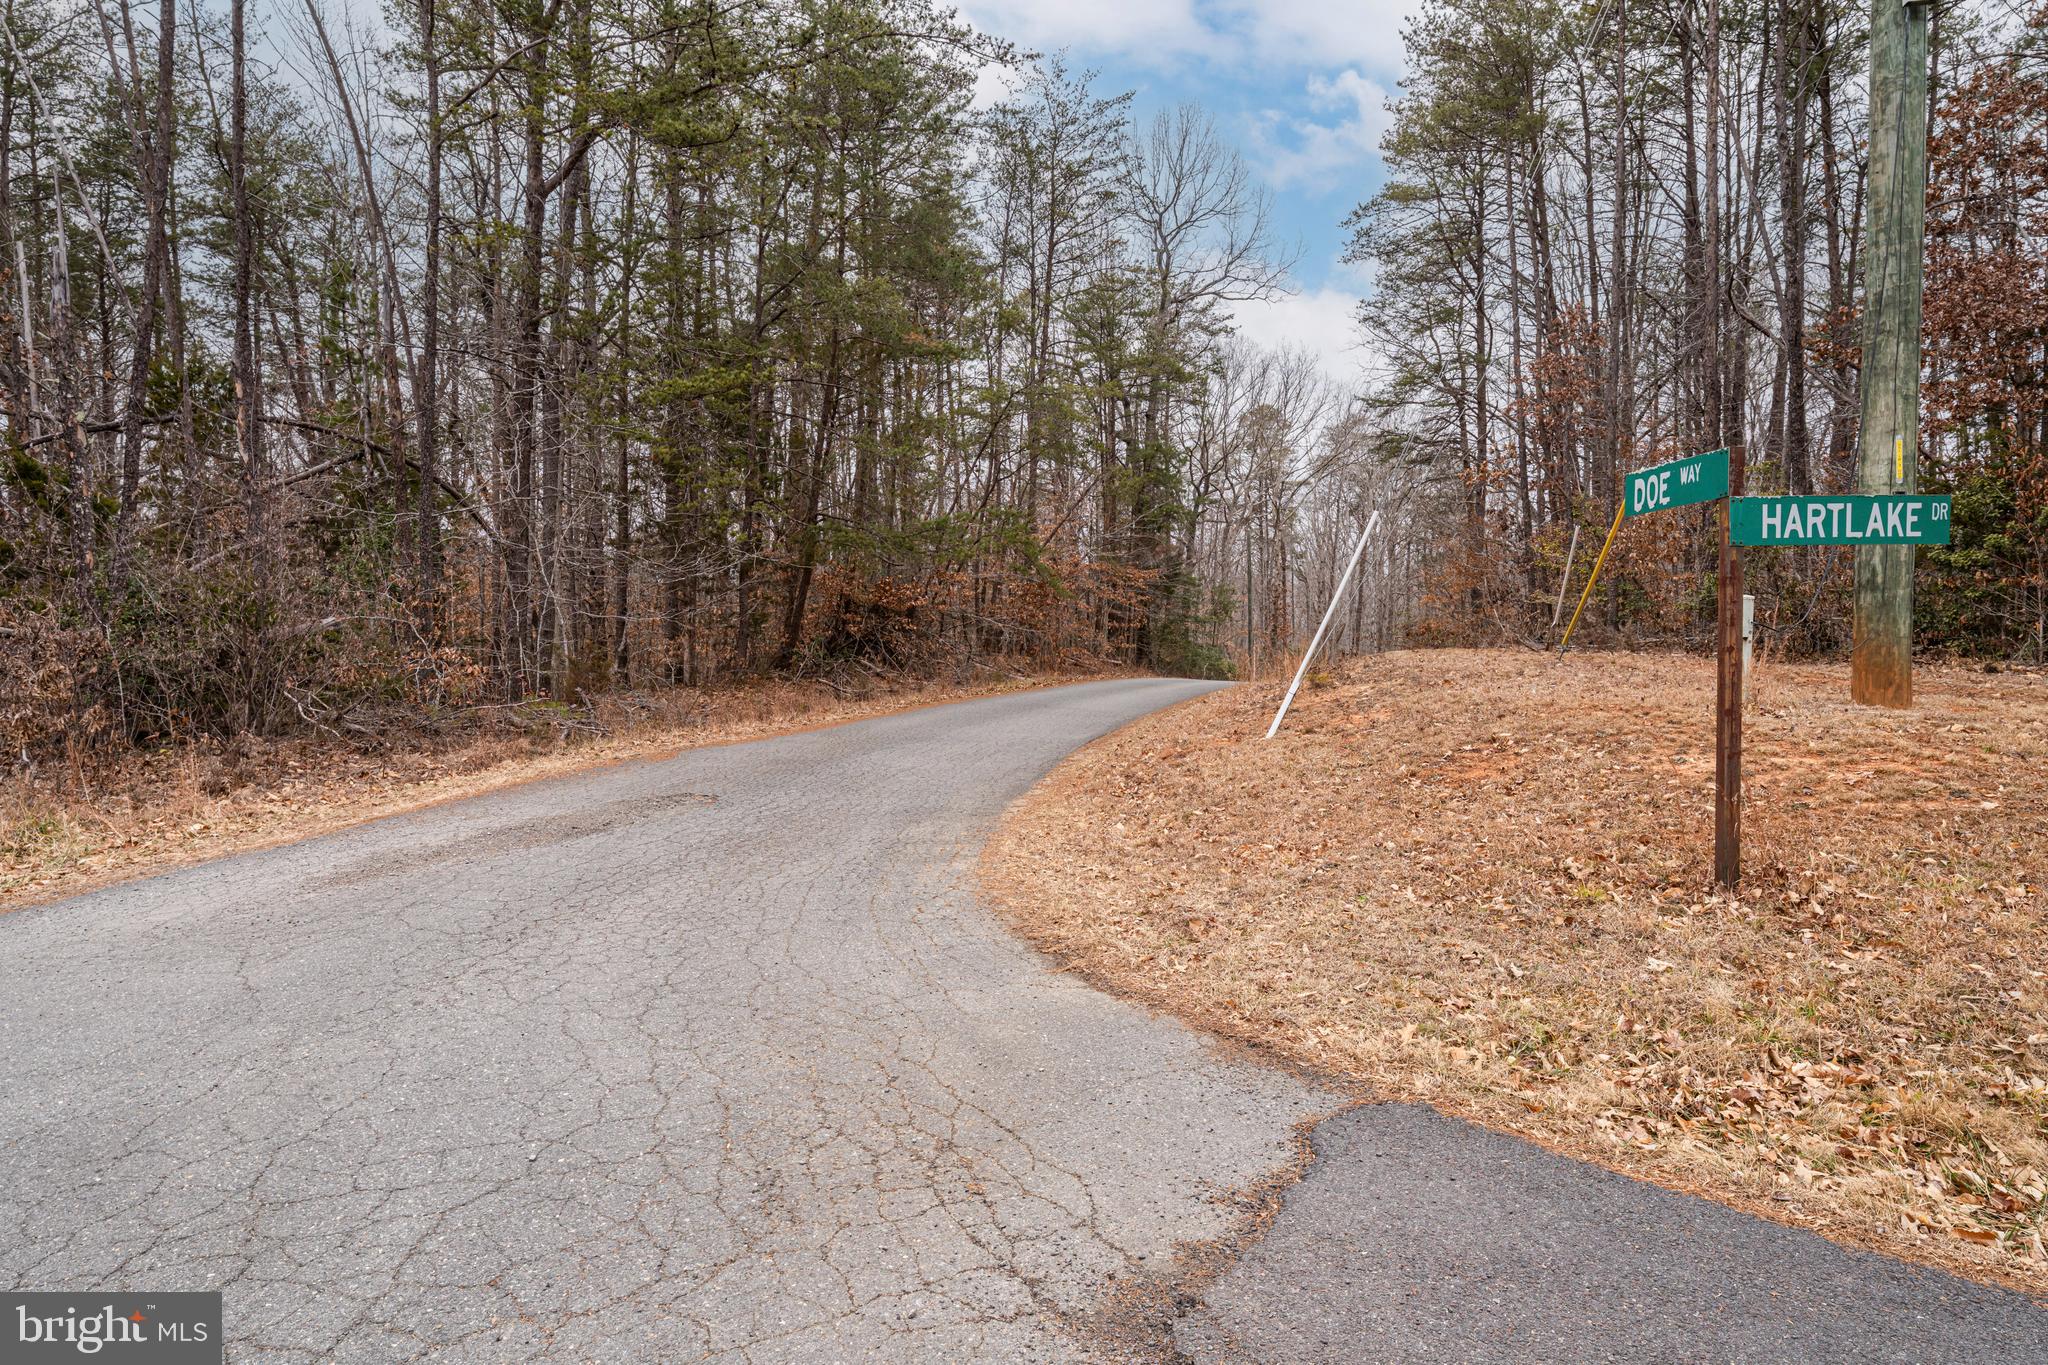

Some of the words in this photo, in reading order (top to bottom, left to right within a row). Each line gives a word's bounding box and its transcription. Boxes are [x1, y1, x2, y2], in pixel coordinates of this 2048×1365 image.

[1633, 471, 1671, 513] DOE
[1679, 463, 1702, 486] WAY
[1761, 502, 1922, 539] HARTLAKE
[1931, 502, 1948, 521] DR
